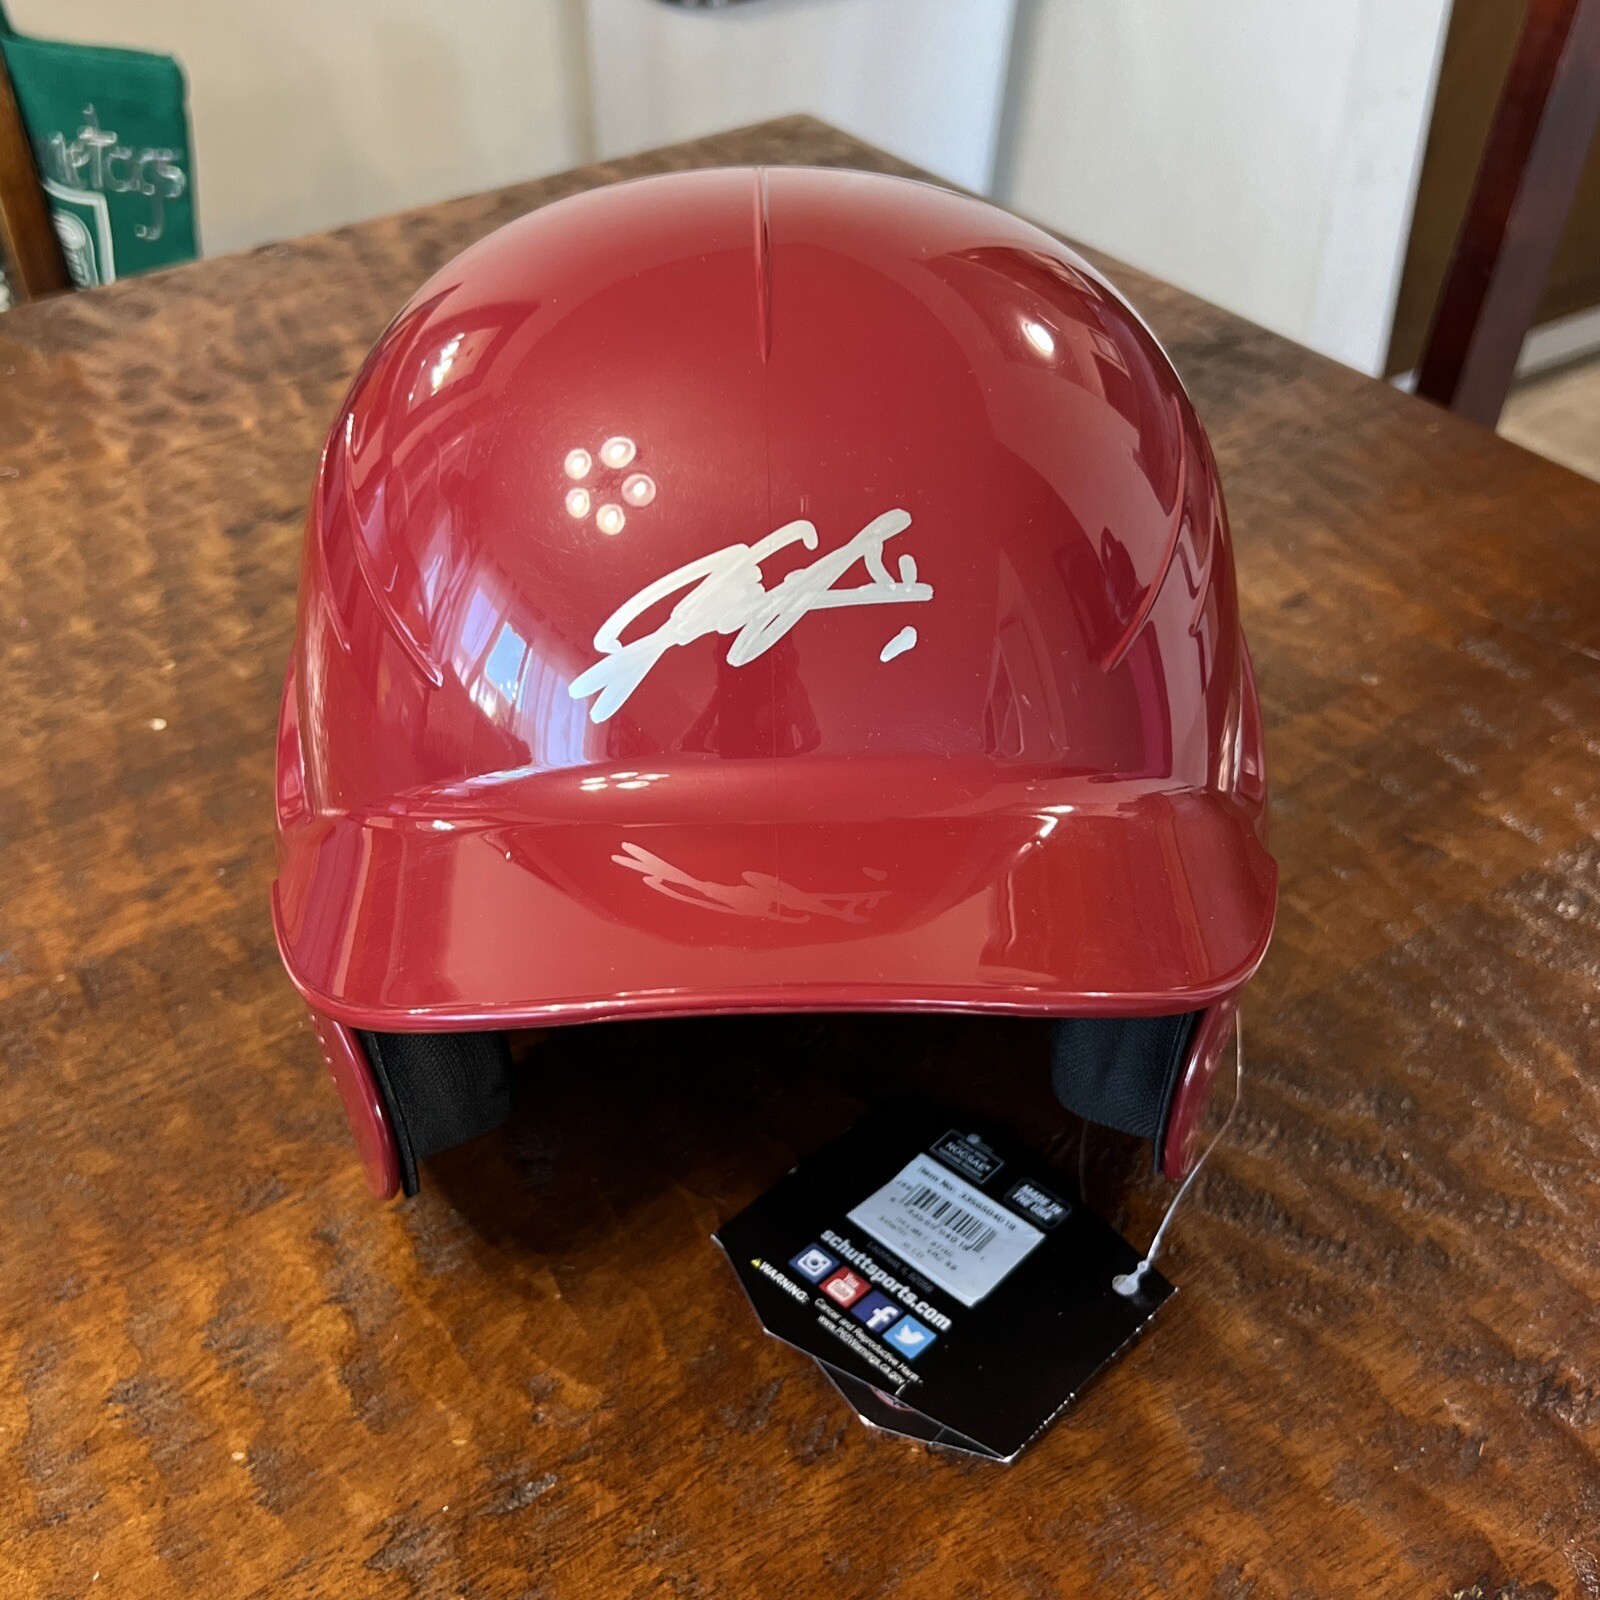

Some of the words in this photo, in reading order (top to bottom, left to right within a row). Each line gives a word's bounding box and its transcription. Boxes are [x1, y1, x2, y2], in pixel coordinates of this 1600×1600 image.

[1012, 1191, 1033, 1208] THE
[1030, 1203, 1053, 1220] USA
[1018, 1184, 1051, 1206] MADE
[1048, 1201, 1063, 1214] IN
[819, 1229, 953, 1333] schuttsports.com
[814, 1297, 842, 1322] Cancer
[839, 1316, 855, 1330] and
[852, 1326, 899, 1366] Reproductive
